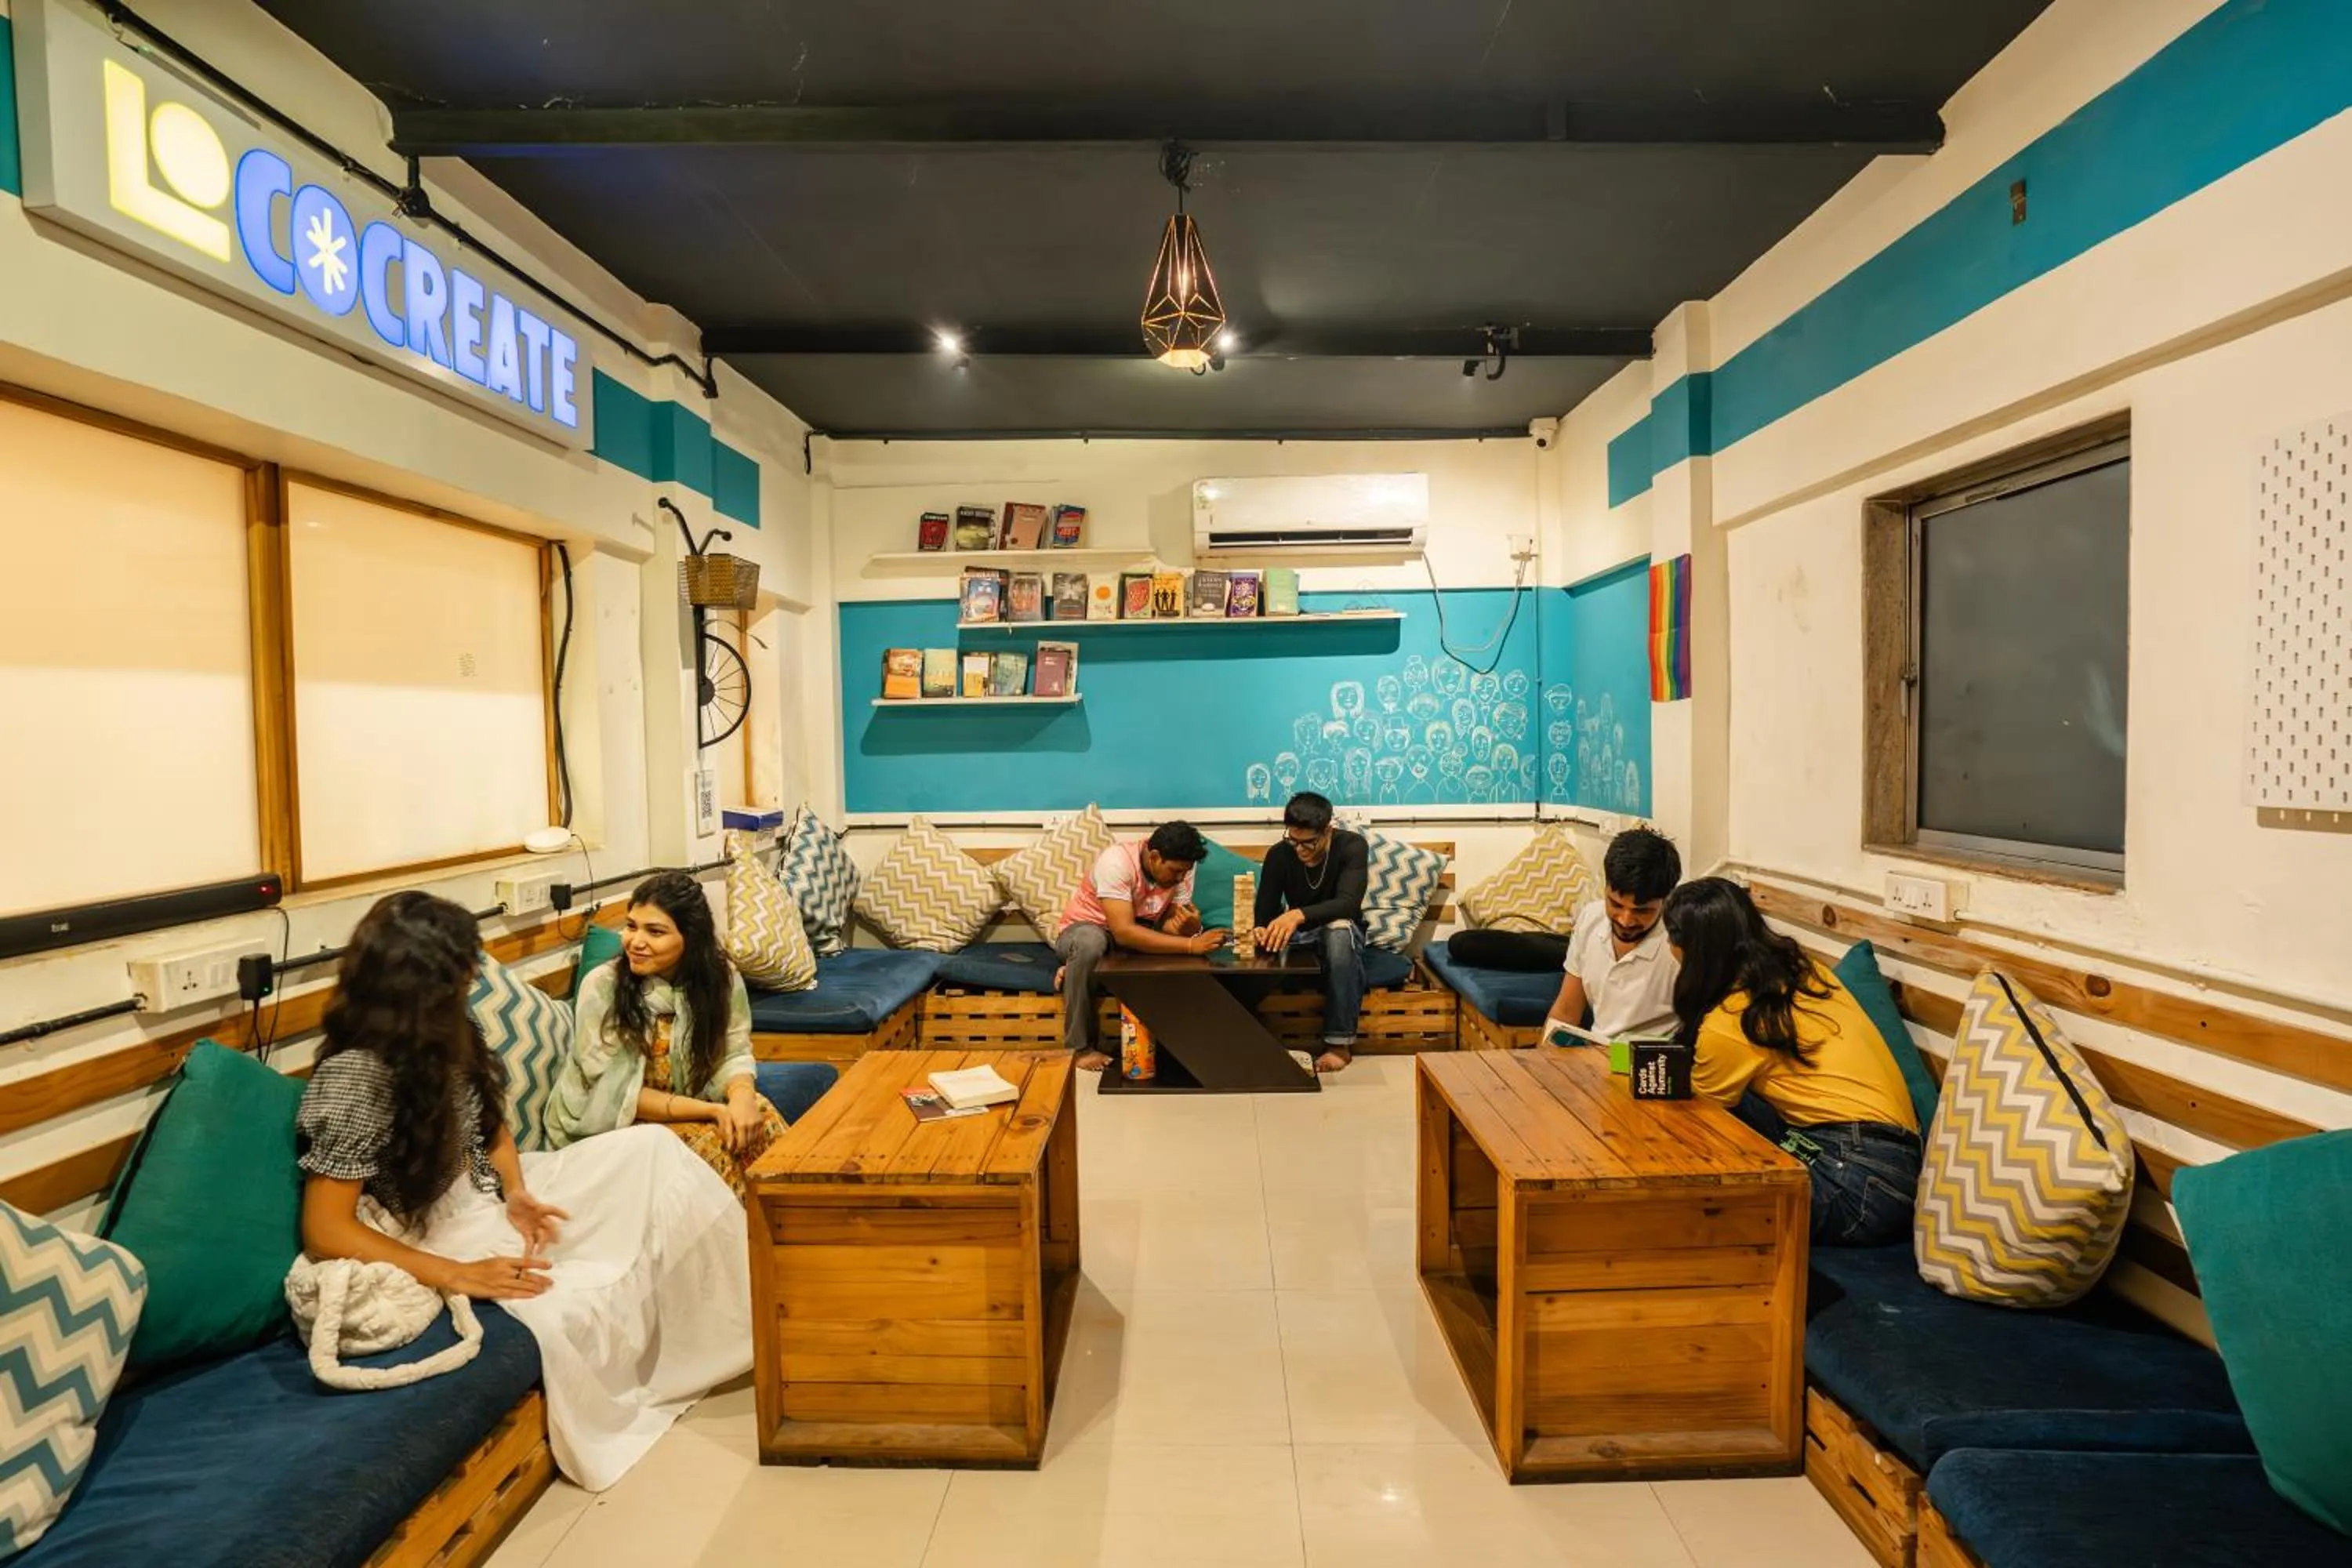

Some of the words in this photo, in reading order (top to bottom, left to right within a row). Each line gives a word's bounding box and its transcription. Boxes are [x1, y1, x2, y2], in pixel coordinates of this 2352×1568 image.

[1639, 1068, 1647, 1094] Cards
[1647, 1062, 1657, 1094] Against
[1657, 1054, 1668, 1094] Humanity
